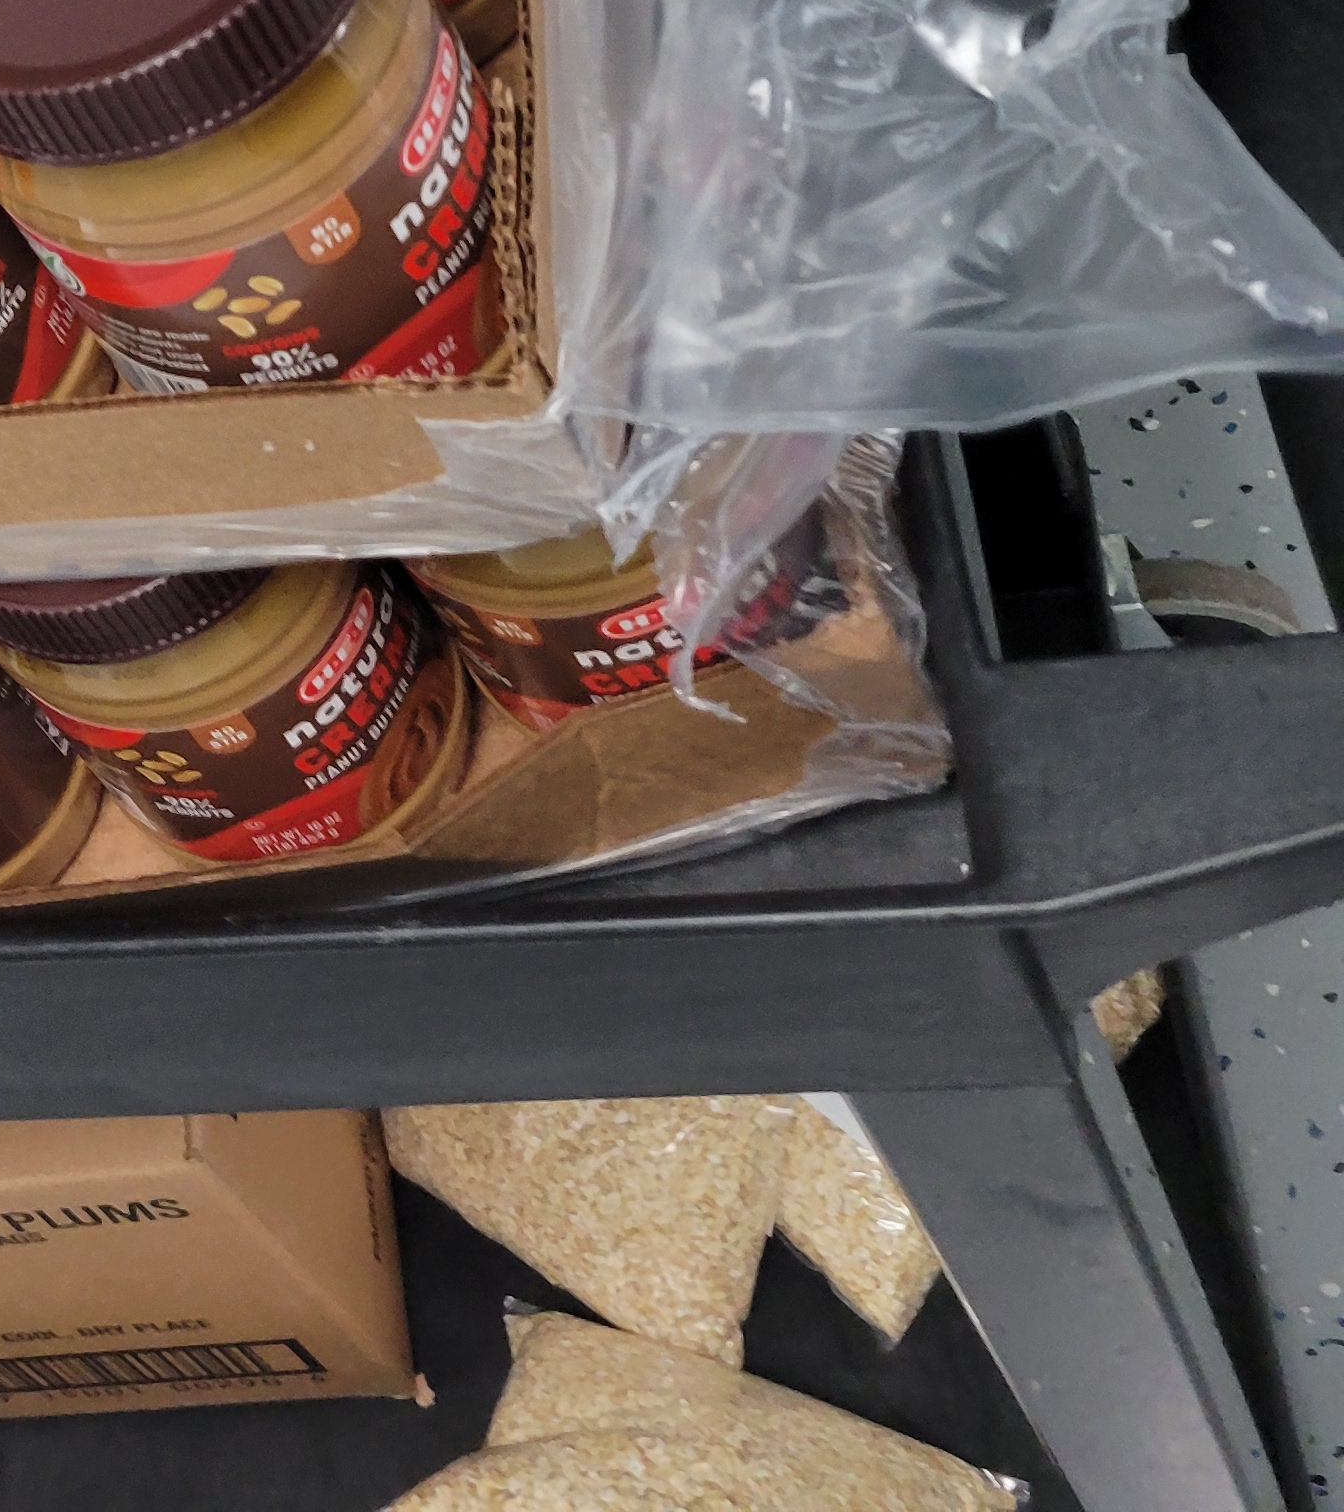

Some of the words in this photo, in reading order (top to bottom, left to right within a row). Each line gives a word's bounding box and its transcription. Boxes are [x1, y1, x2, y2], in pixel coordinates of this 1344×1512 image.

[414, 226, 476, 306] PEANUT
[303, 737, 367, 790] PEANUT
[0, 1197, 192, 1235] PLUMS
[133, 1316, 215, 1335] PLACE
